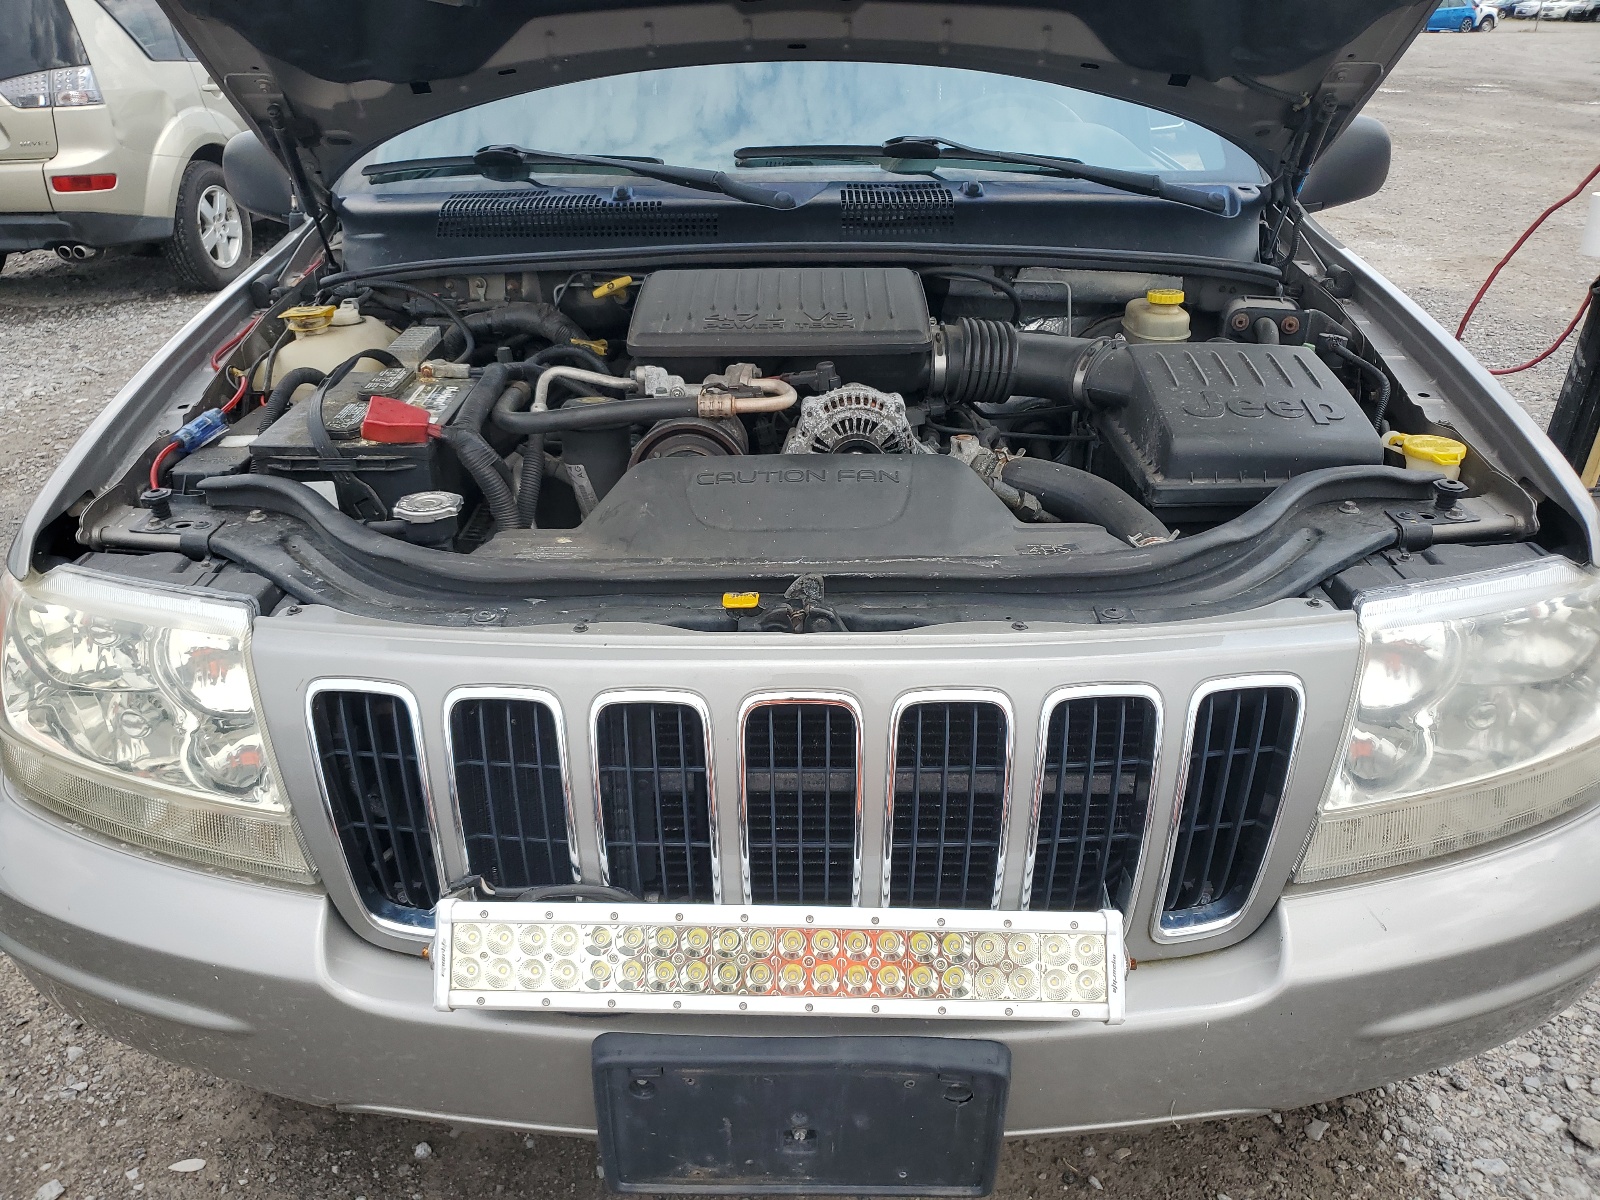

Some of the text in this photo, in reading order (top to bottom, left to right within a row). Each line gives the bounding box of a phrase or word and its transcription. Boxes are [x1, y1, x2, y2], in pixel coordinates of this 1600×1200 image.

[1182, 390, 1346, 425] Jeep
[696, 469, 900, 486] CAUTION FAN
